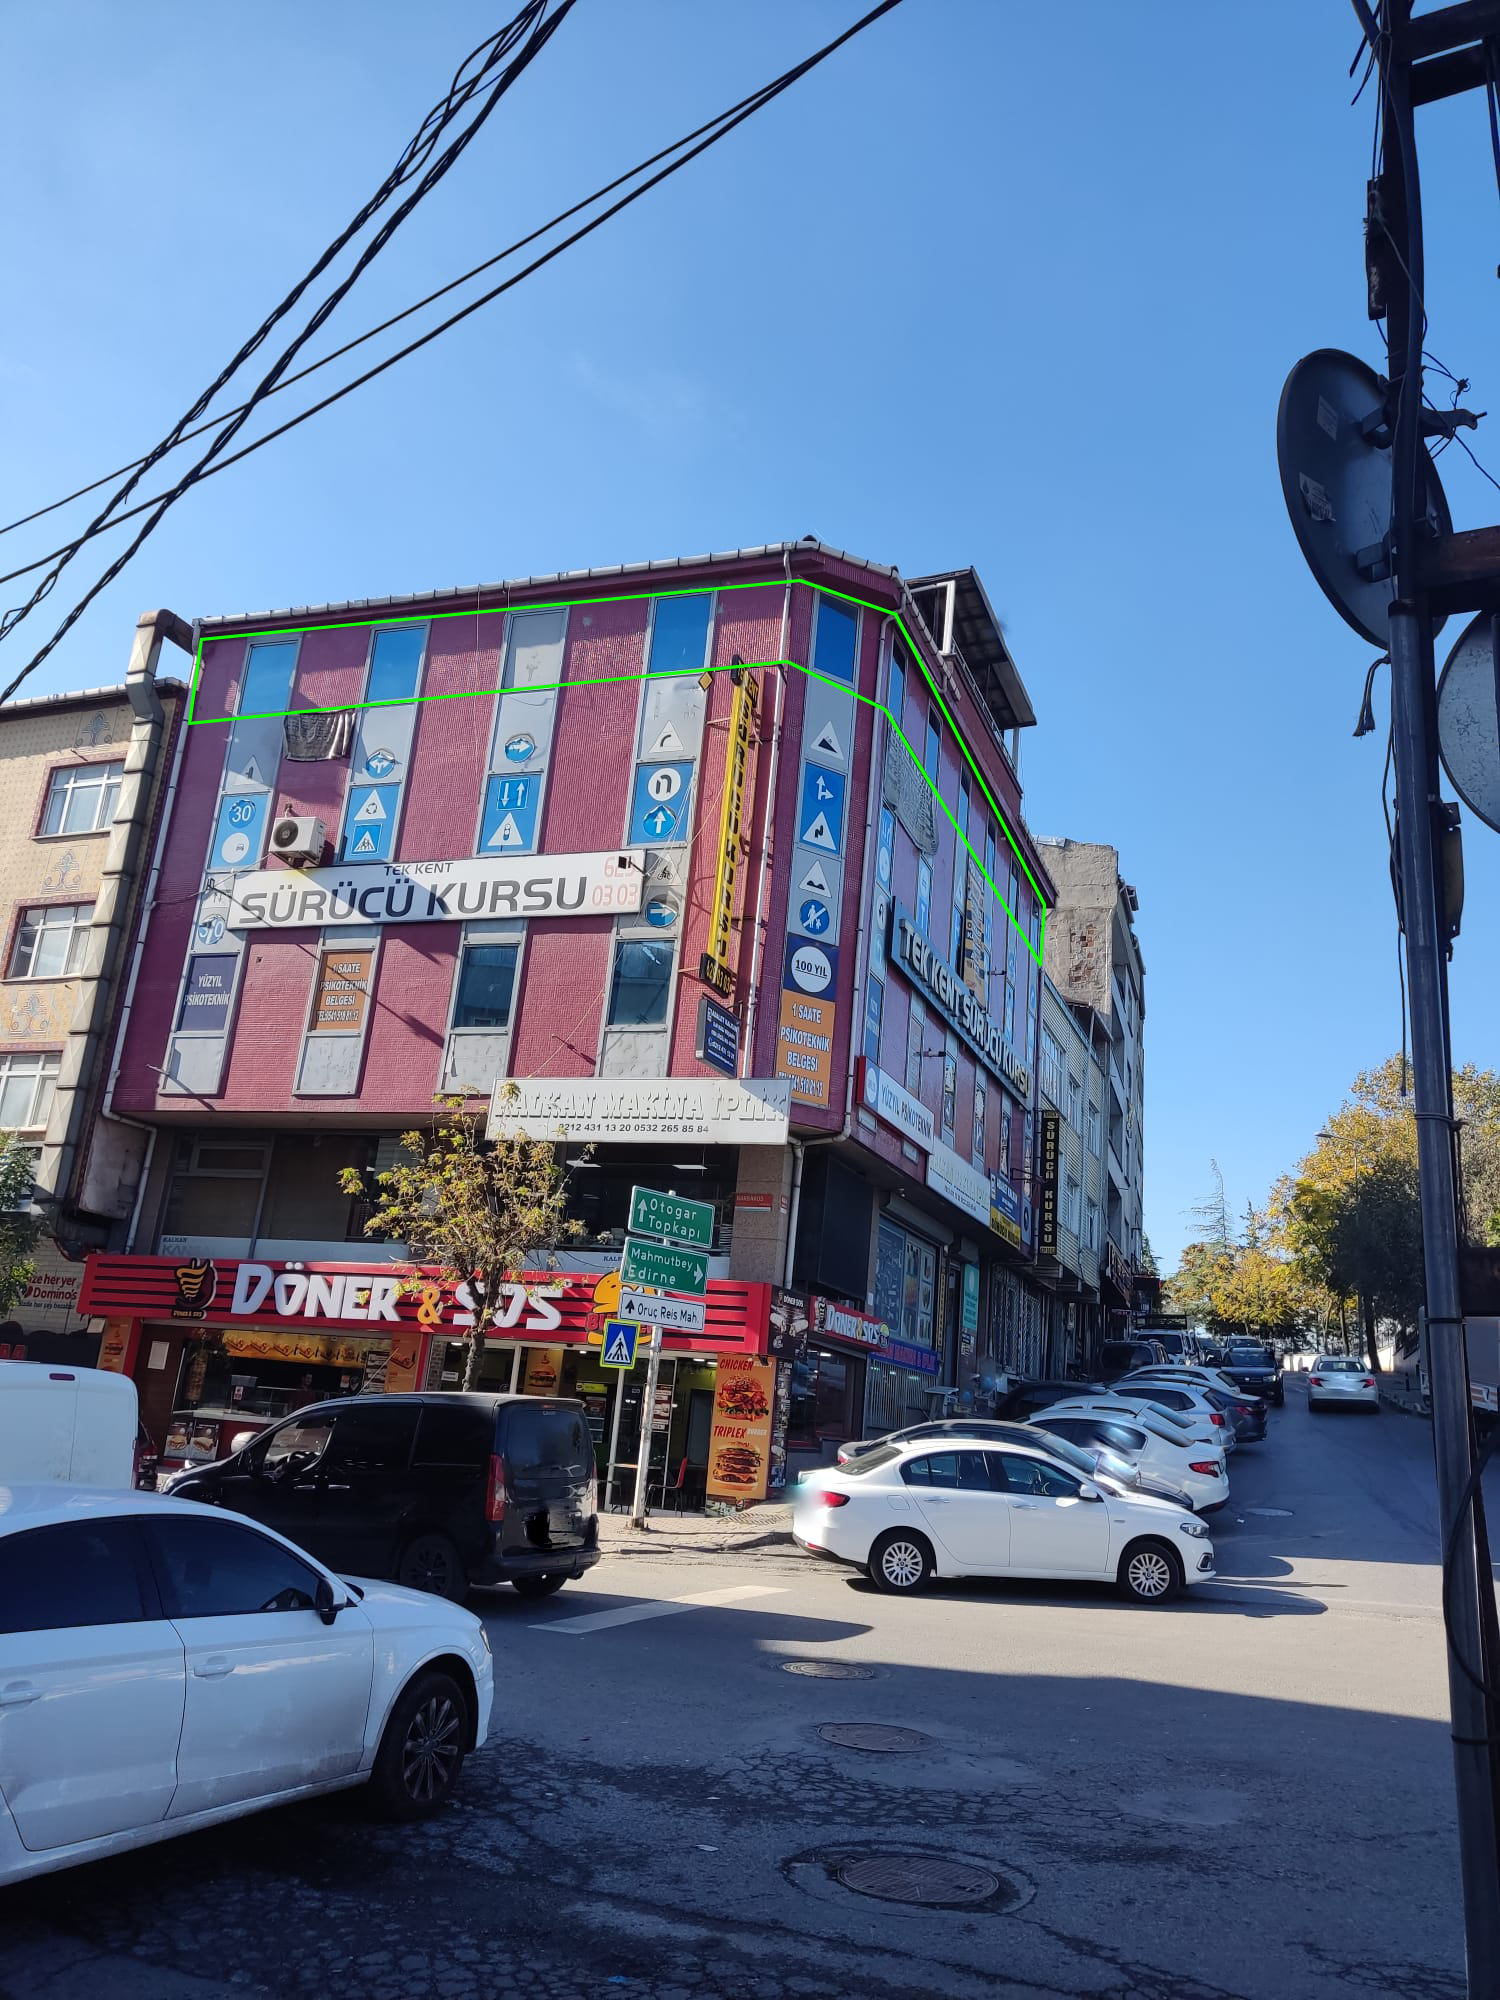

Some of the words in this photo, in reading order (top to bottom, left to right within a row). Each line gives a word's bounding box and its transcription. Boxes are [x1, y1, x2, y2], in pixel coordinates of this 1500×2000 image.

[231, 805, 251, 823] 30
[384, 864, 409, 877] TEK
[414, 862, 454, 875] KENT
[238, 877, 416, 924] SÜRÜCÜ
[426, 876, 588, 916] KURSU
[337, 962, 361, 974] SAATE
[795, 959, 812, 973] 100
[814, 962, 828, 978] YIL
[198, 973, 222, 988] YÜZYIL
[184, 990, 231, 1006] PSİKOTEKNİK
[325, 992, 356, 1006] BELGESİ
[899, 918, 931, 984] TEK
[930, 957, 962, 1020] KENT
[1001, 1036, 1029, 1098] KURSU
[792, 1001, 797, 1017] 1
[798, 1003, 822, 1024] SAATE
[780, 1025, 831, 1052] PSİKOTEKNİK
[786, 1050, 819, 1072] BELGESİ
[600, 1087, 705, 1119] MAKİNA
[584, 1123, 601, 1132] 431
[605, 1123, 617, 1132] 13
[619, 1123, 632, 1132] 20
[633, 1124, 658, 1133] 0532
[660, 1124, 679, 1133] 265
[681, 1125, 695, 1133] 85
[696, 1125, 709, 1134] 84
[650, 1198, 698, 1221] Otogar
[1042, 1190, 1054, 1243] KURSU
[648, 1214, 701, 1240] Topkapı
[630, 1247, 694, 1272] Mahmutbey
[43, 1273, 60, 1286] her
[60, 1276, 77, 1288] yer
[627, 1264, 677, 1286] Edirne
[33, 1286, 78, 1301] Domino's
[230, 1261, 401, 1322] DÖNER
[417, 1286, 442, 1325] &
[637, 1303, 658, 1319] Oruç
[660, 1305, 678, 1321] Reis
[680, 1308, 700, 1324] Mah.
[719, 1358, 754, 1370] CHICKEN
[713, 1425, 747, 1439] TRIPLEX
